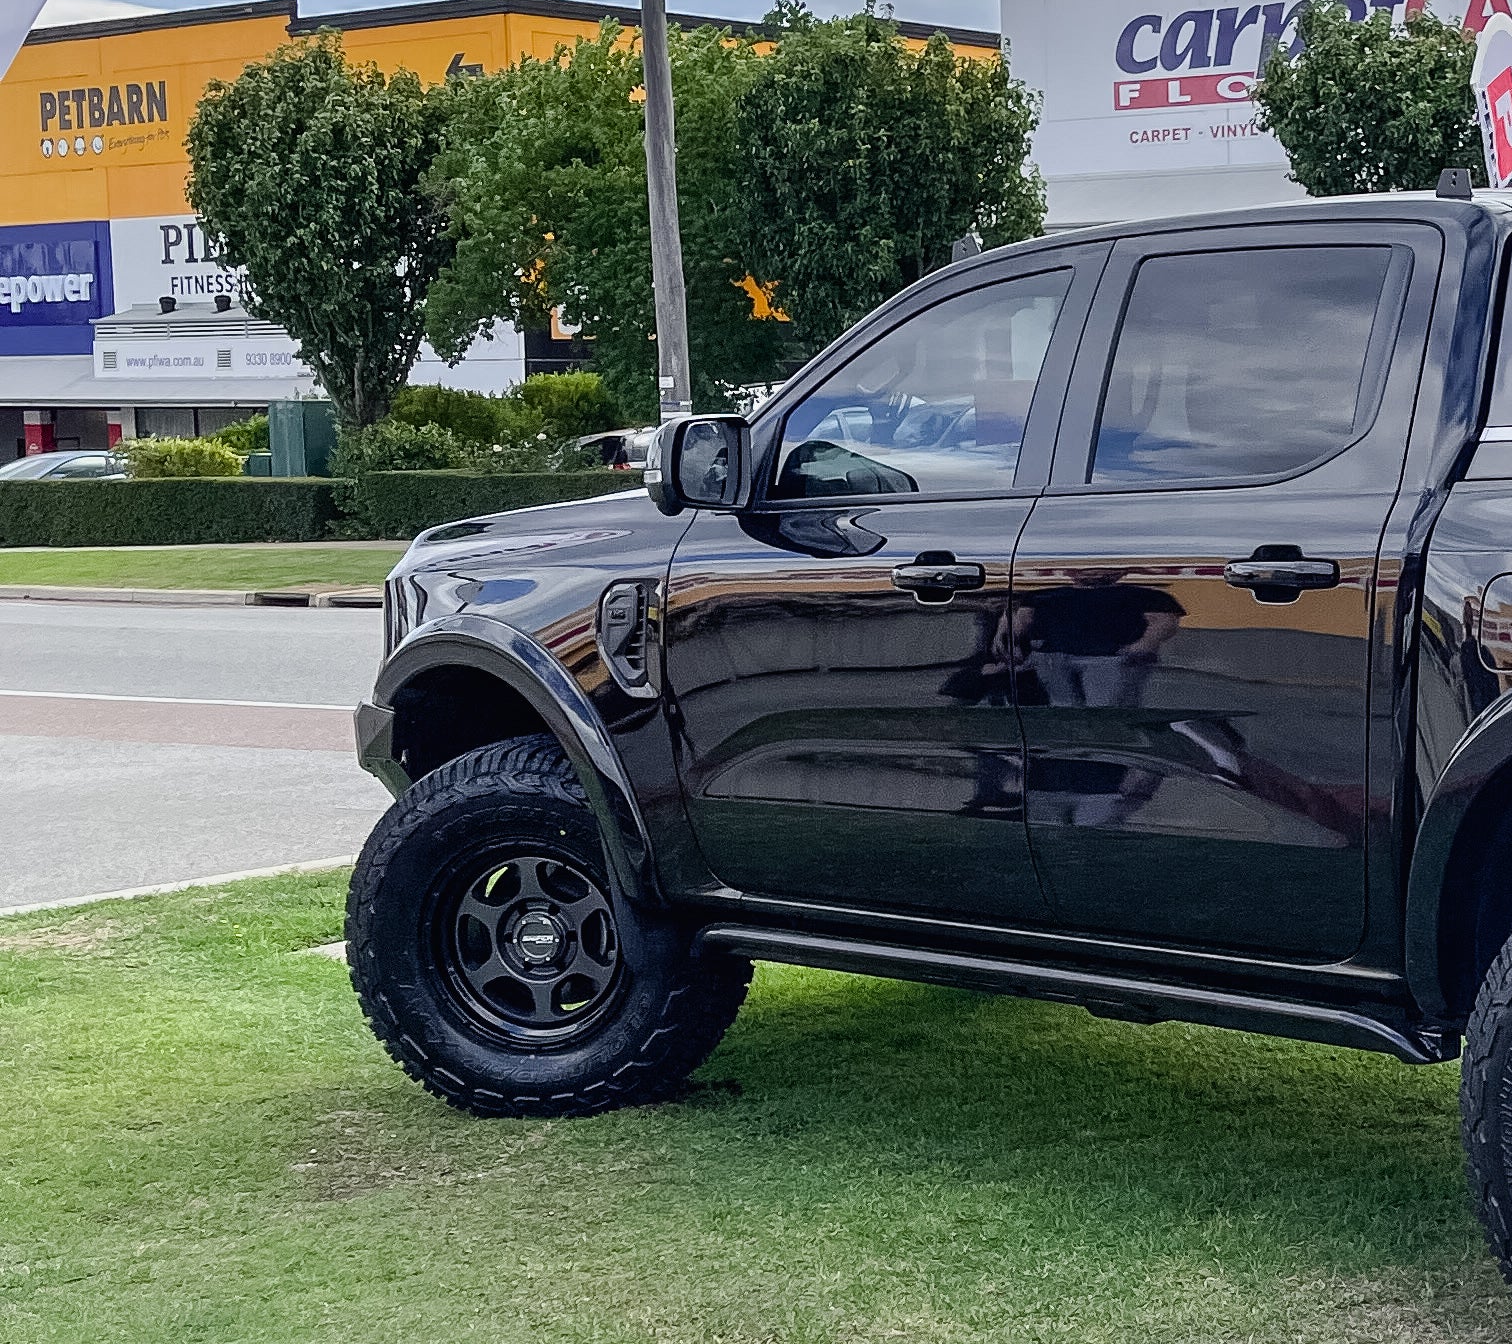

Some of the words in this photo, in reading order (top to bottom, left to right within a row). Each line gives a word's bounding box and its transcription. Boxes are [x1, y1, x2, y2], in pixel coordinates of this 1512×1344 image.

[40, 80, 168, 132] PETBARN
[1130, 127, 1191, 144] CARPET
[1210, 123, 1259, 139] VINYL
[171, 274, 235, 295] FITNESS
